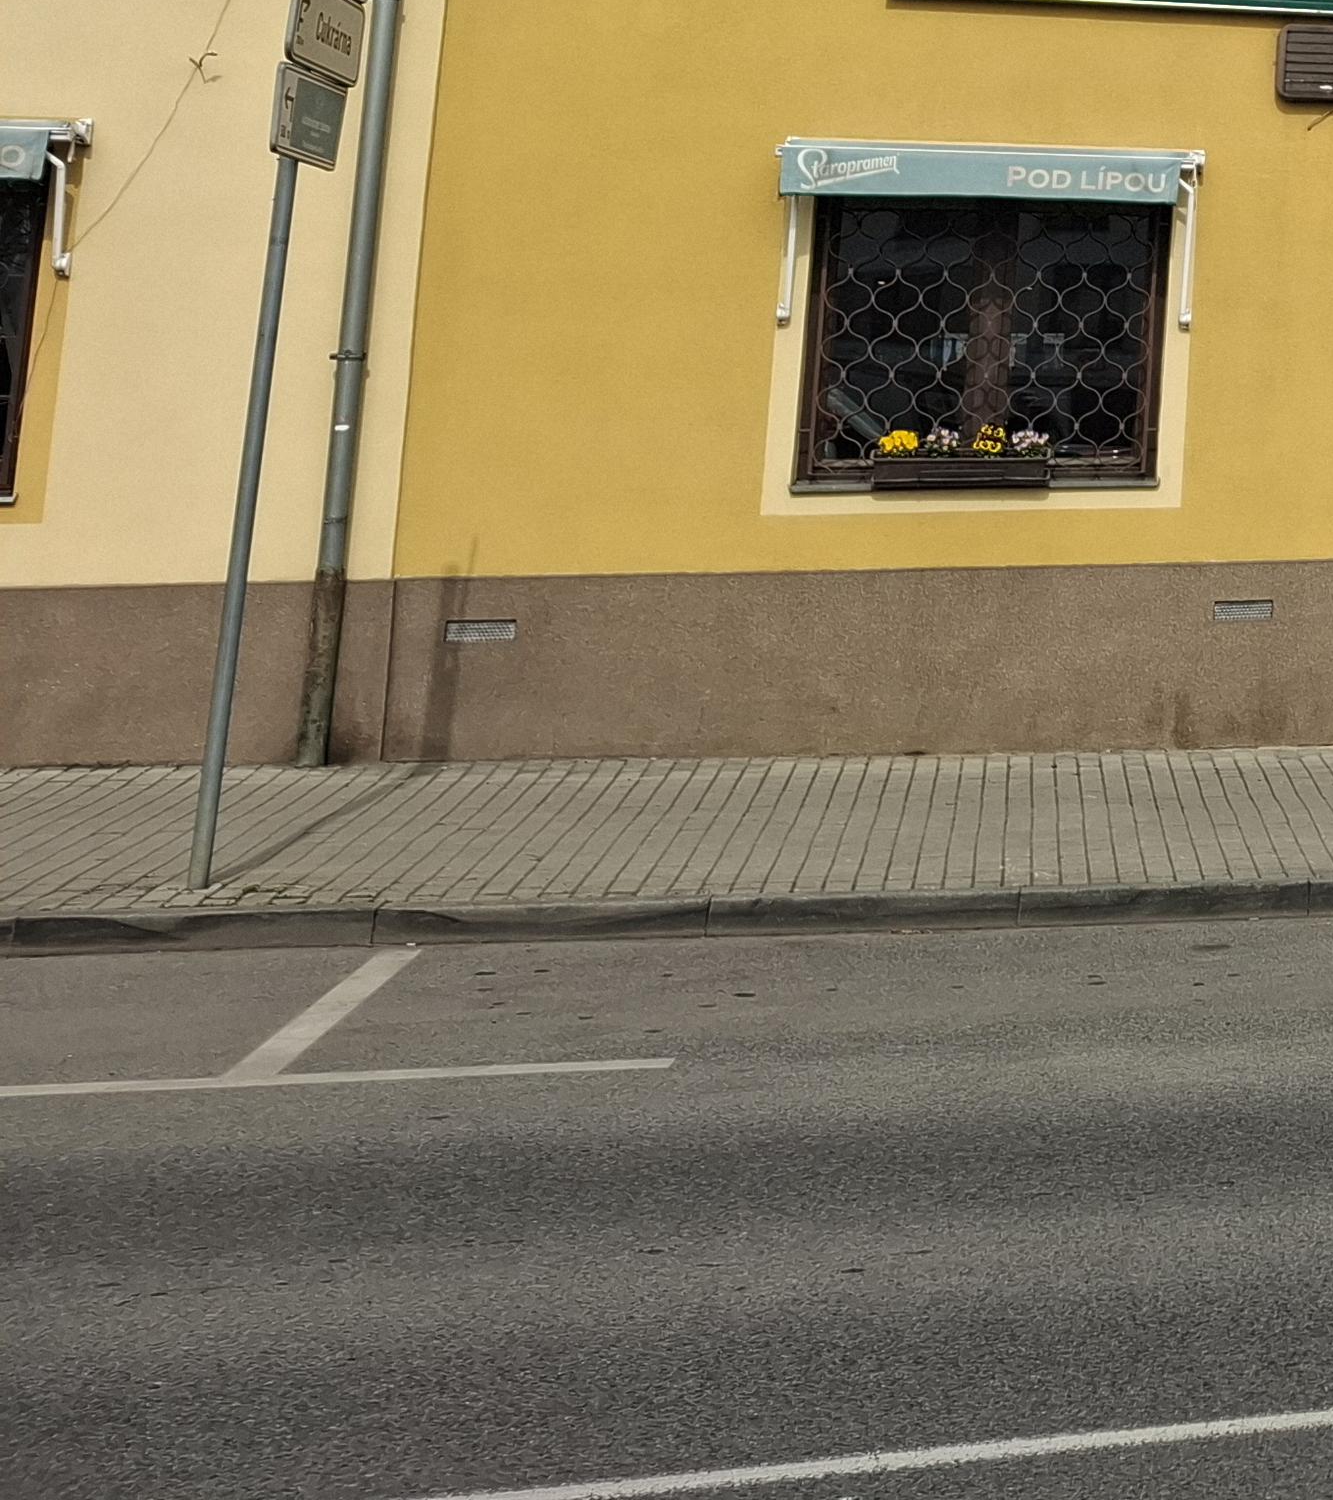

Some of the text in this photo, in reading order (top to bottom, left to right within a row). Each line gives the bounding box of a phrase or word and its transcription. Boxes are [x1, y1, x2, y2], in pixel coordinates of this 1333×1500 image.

[316, 12, 352, 56] Cukrárna
[797, 148, 900, 190] Staropramen
[1007, 165, 1167, 193] POD LÍPOU
